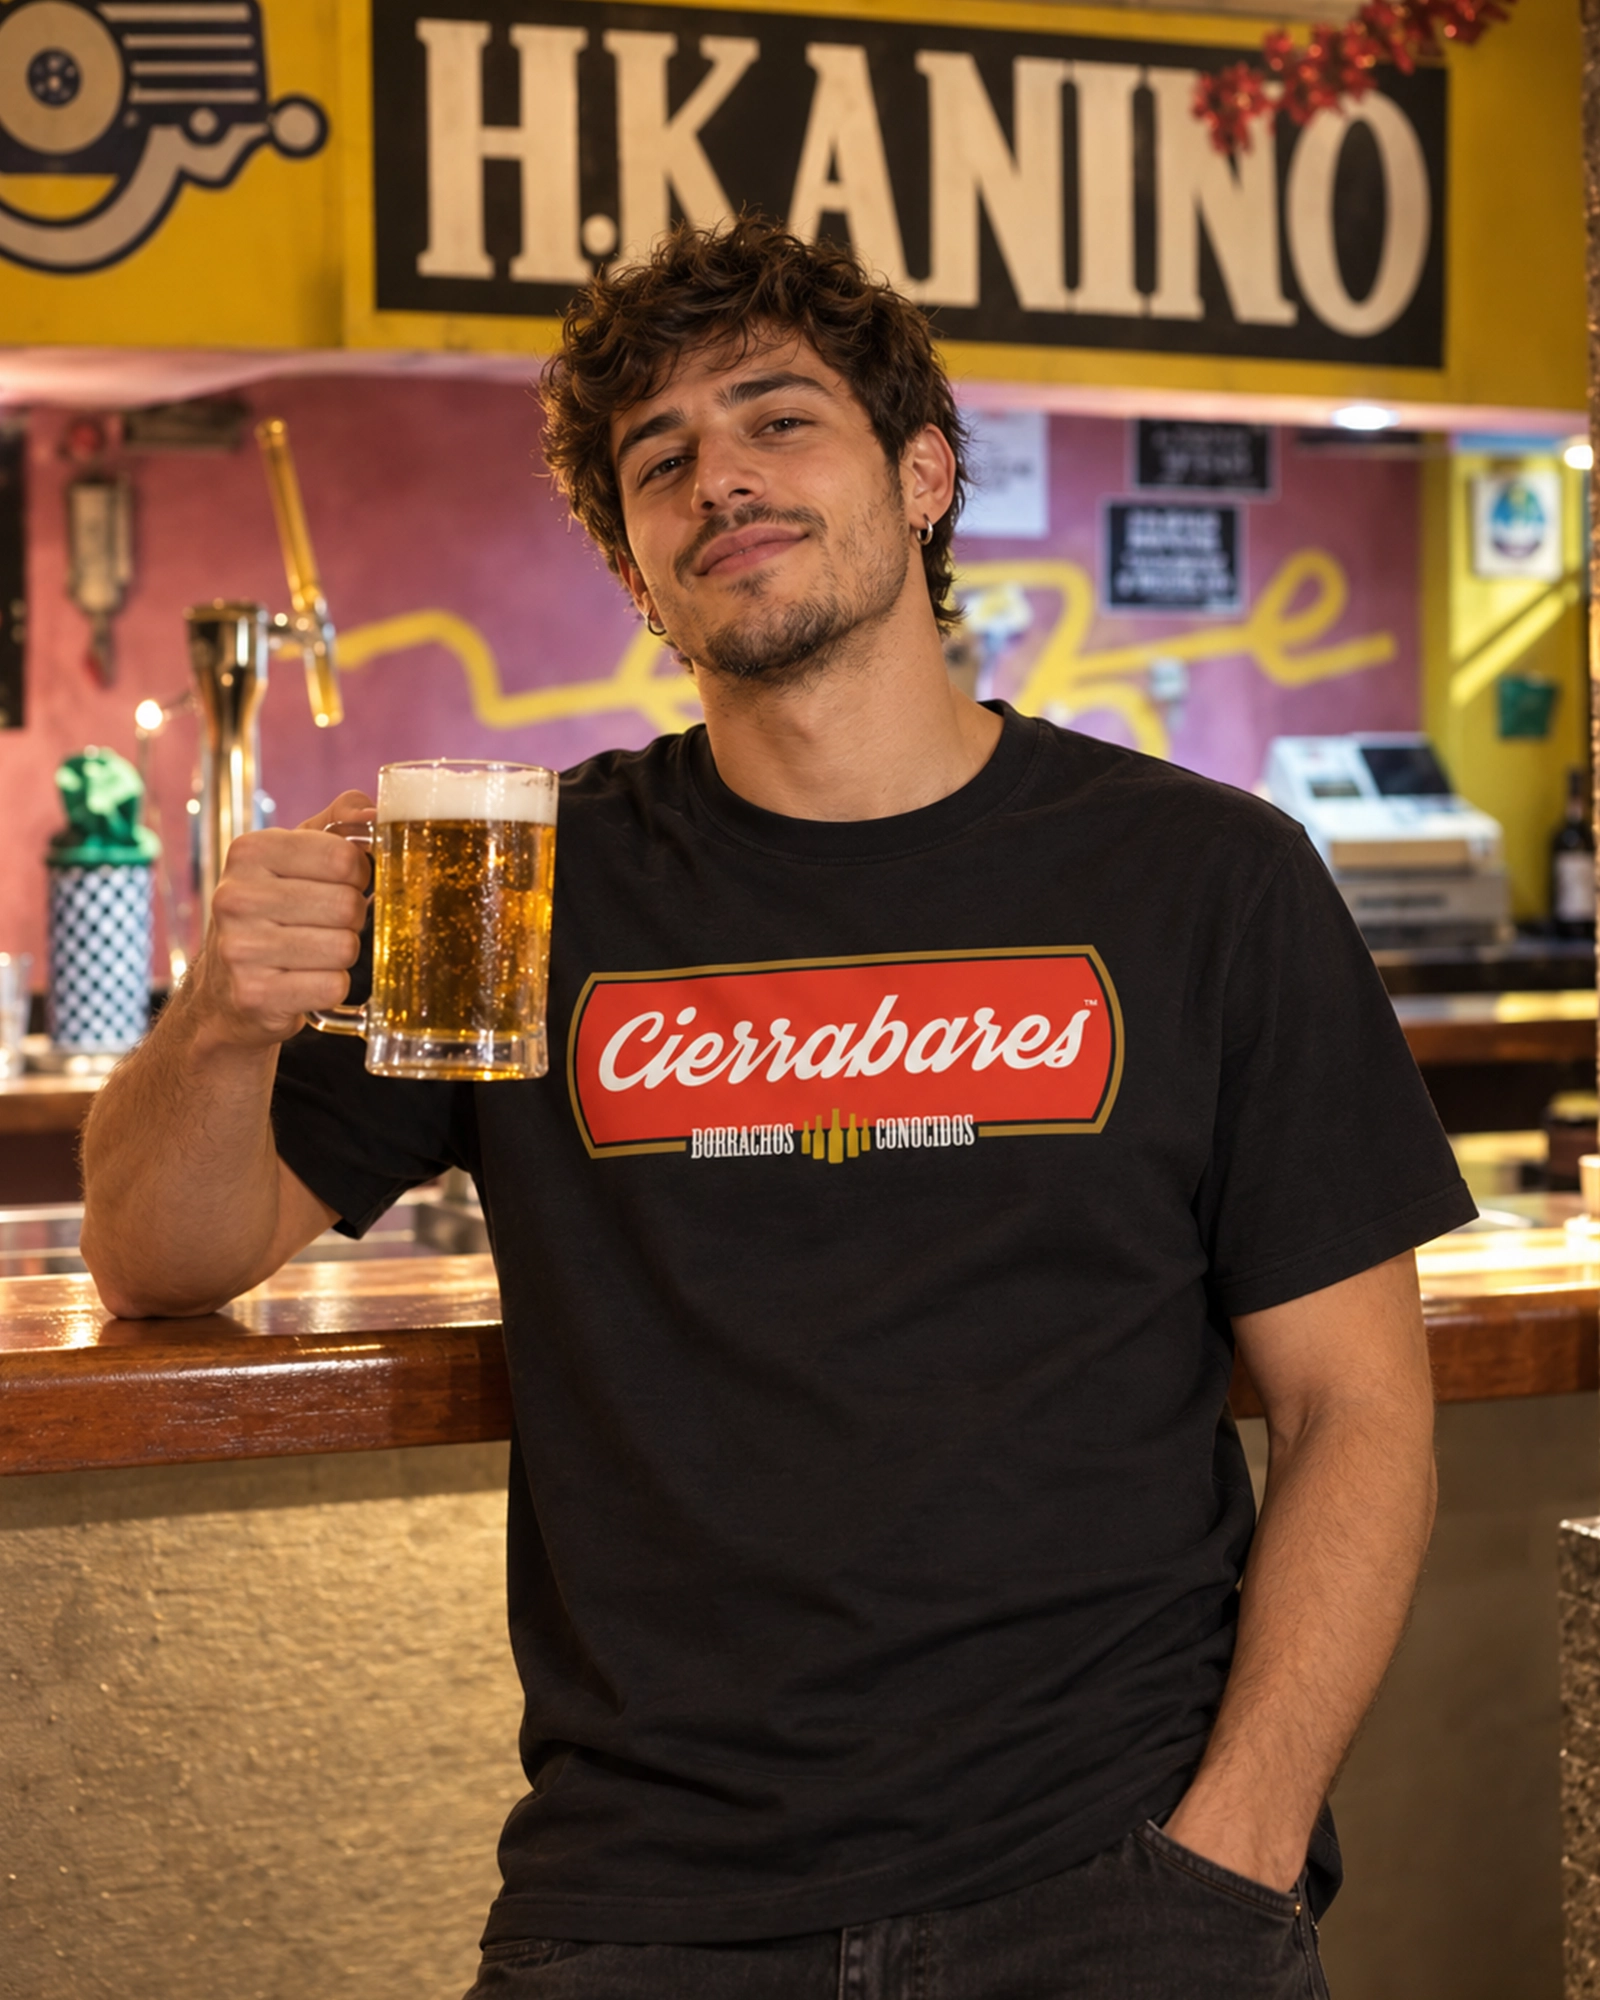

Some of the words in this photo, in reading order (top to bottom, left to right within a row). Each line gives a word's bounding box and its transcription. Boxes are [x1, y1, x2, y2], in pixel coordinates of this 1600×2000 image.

[599, 994, 1091, 1092] Cierrabares
[690, 1123, 795, 1159] BORRACHOS
[875, 1114, 975, 1149] CONOCIDOS
